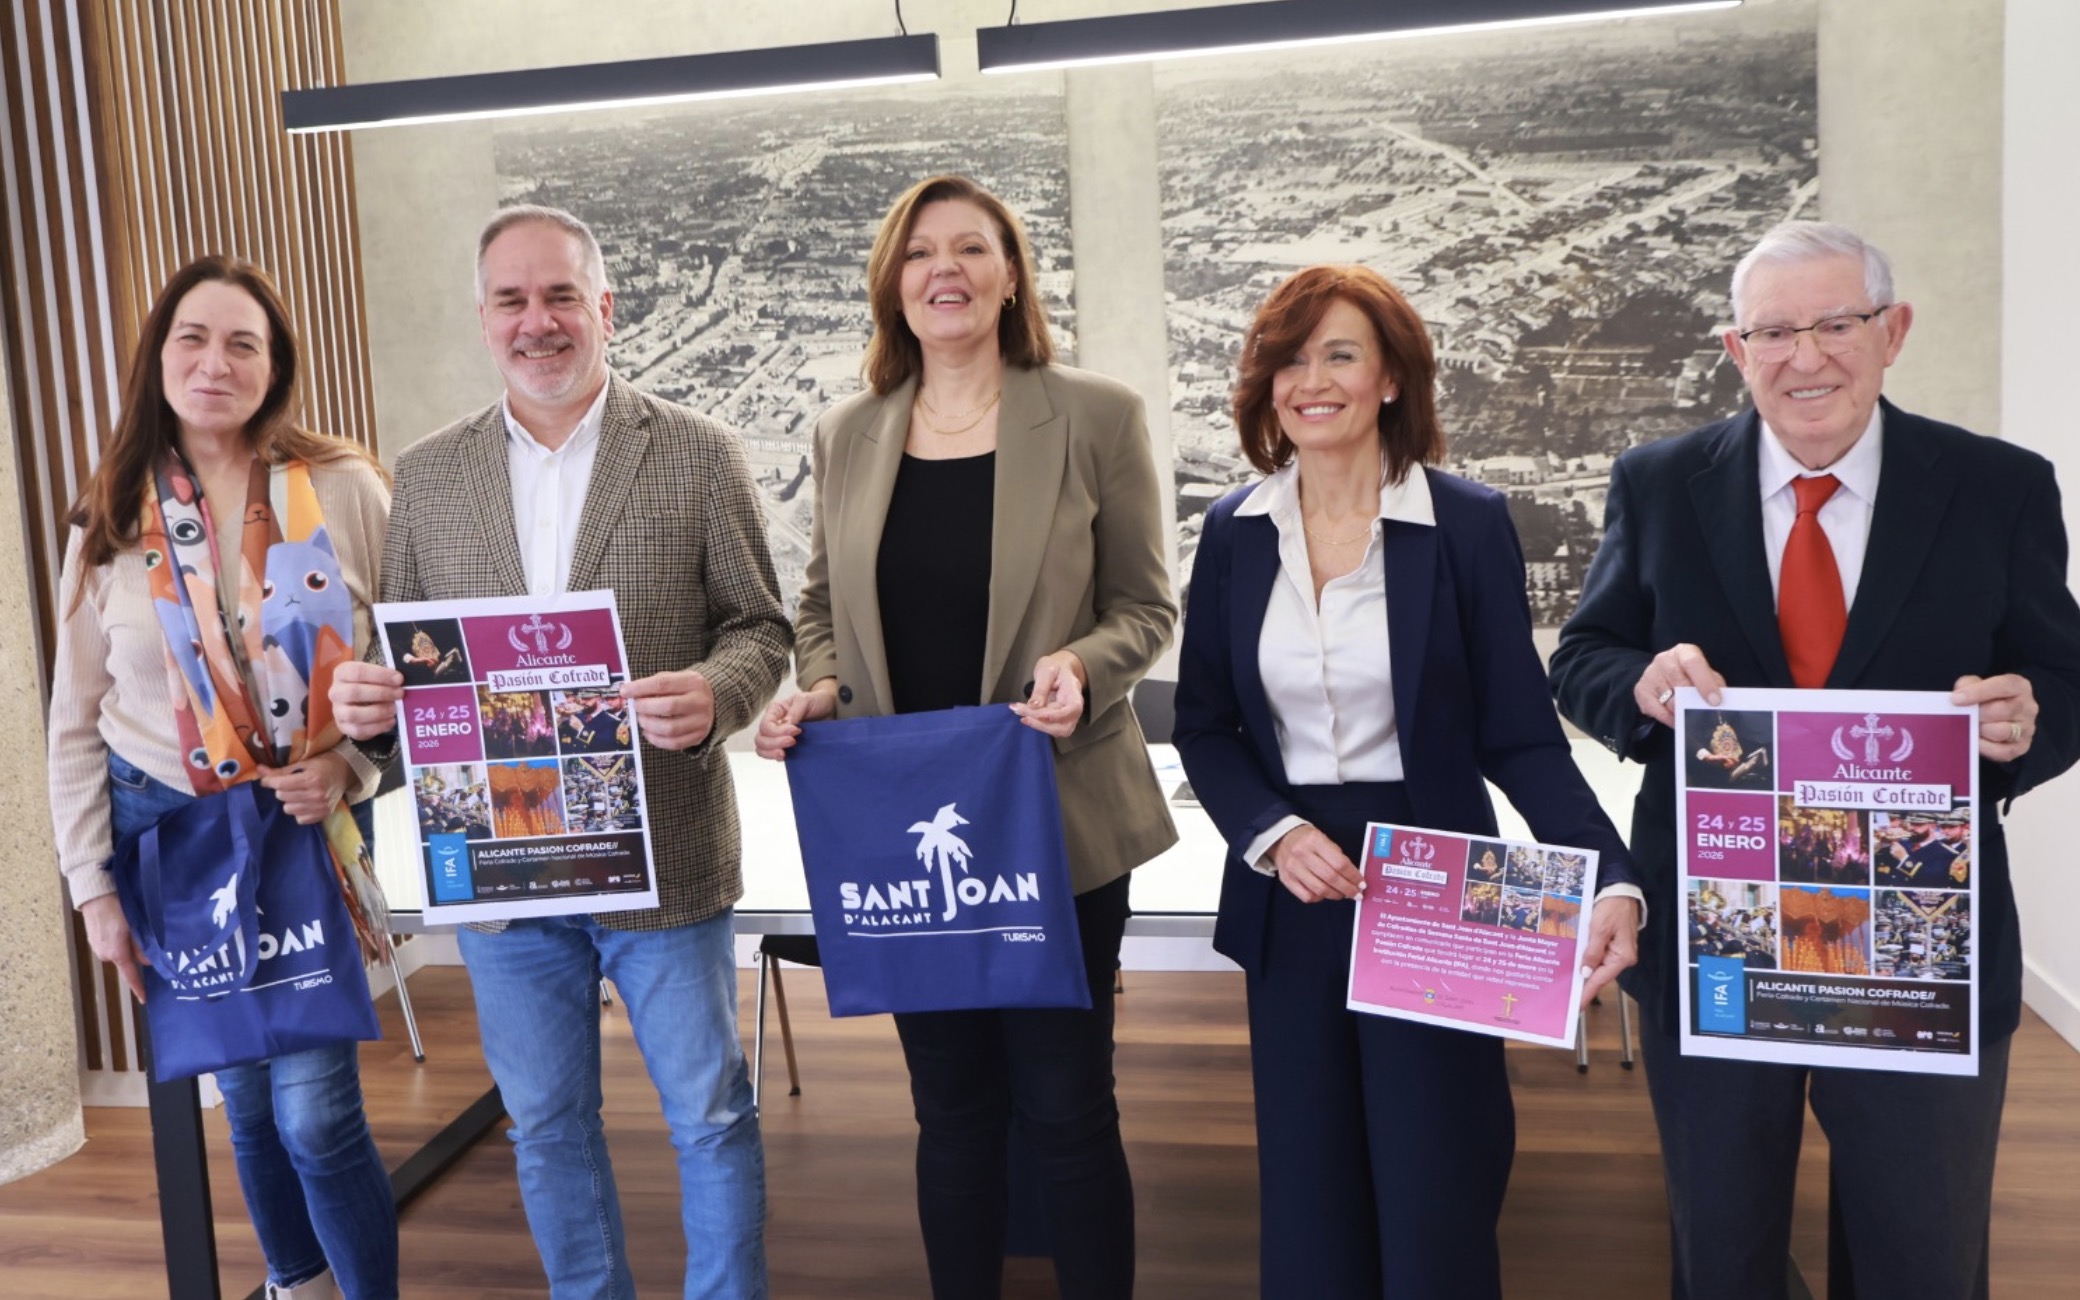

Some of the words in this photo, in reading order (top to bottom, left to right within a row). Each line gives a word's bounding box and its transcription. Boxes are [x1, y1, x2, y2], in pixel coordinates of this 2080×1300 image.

[515, 652, 576, 668] Alicante
[492, 671, 544, 690] Pasión
[549, 668, 606, 684] Cofrade
[413, 707, 436, 722] 24
[449, 705, 470, 720] 25
[415, 721, 472, 738] ENERO
[418, 740, 440, 749] 2026
[1833, 764, 1912, 781] Alicante
[1798, 785, 1864, 804] Pasión
[1873, 787, 1946, 806] Cofrade
[1696, 814, 1723, 830] 24
[1728, 821, 1735, 830] y
[1738, 816, 1766, 832] 25
[1697, 832, 1766, 850] ENERO
[478, 848, 526, 858] ALICANTE
[527, 845, 564, 855] PASION
[1698, 850, 1724, 860] 2026
[444, 857, 458, 877] IFA
[840, 880, 930, 910] SANT
[1386, 885, 1398, 894] 24
[1404, 888, 1416, 897] 25
[844, 912, 931, 926] D'ALACANT
[1001, 932, 1046, 942] TURISMO
[293, 974, 333, 991] TURISMO
[1756, 981, 1816, 994] ALICANTE
[1818, 985, 1865, 996] PASION
[1867, 988, 1936, 1000] COFRADE//
[1714, 984, 1728, 1006] IFA
